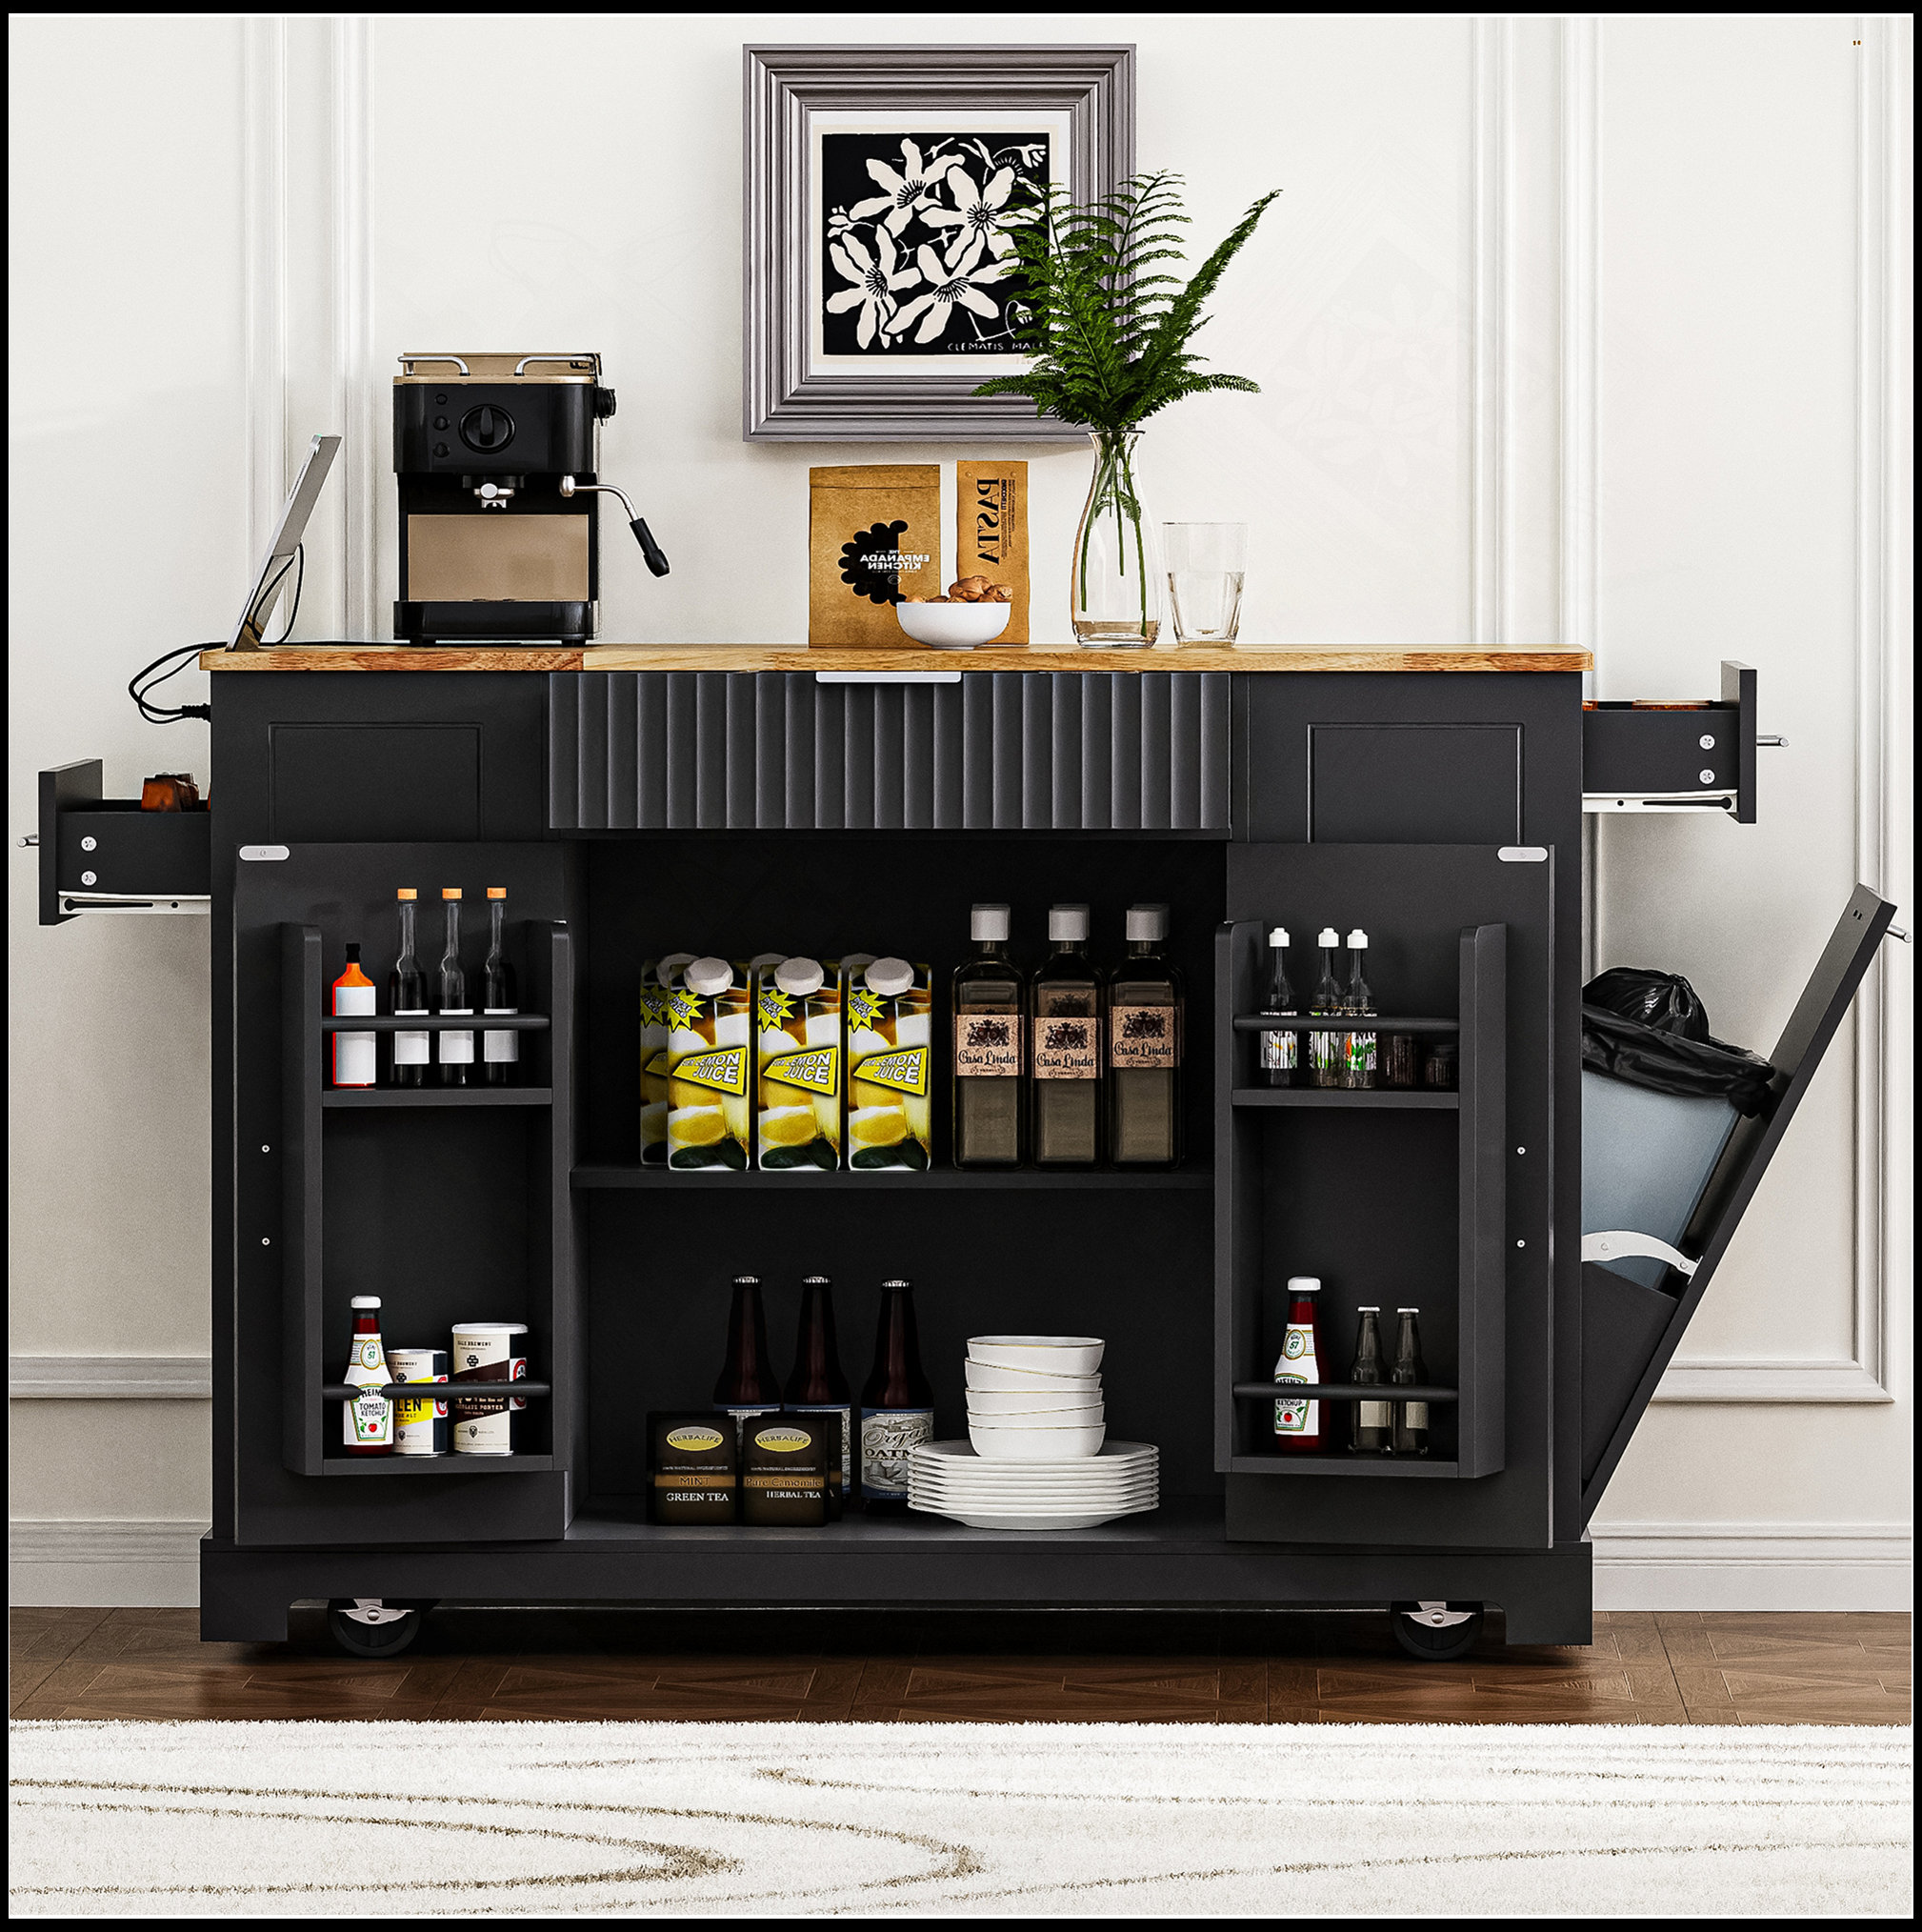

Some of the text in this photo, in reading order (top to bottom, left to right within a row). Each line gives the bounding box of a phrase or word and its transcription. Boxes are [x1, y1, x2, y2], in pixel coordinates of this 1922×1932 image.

[947, 342, 1004, 352] CLEMATIS
[1113, 1041, 1171, 1057] Casa Linda
[695, 1052, 741, 1067] LEMON
[786, 1052, 831, 1067] LEMON
[875, 1052, 921, 1067] LEMON
[958, 1050, 1016, 1066] Casa Linda
[1036, 1053, 1094, 1069] Casa Linda
[692, 1065, 738, 1084] JUICE
[783, 1065, 830, 1084] JUICE
[873, 1065, 919, 1084] JUICE
[1289, 1340, 1300, 1350] 57
[362, 1388, 382, 1398] HEIN
[669, 1434, 720, 1443] HERBALIFE
[757, 1435, 809, 1444] HERBALIFE
[863, 1428, 929, 1449] Orga
[679, 1477, 711, 1486] MINT
[771, 1478, 821, 1487] Camomile
[666, 1493, 729, 1501] GREEN TEA
